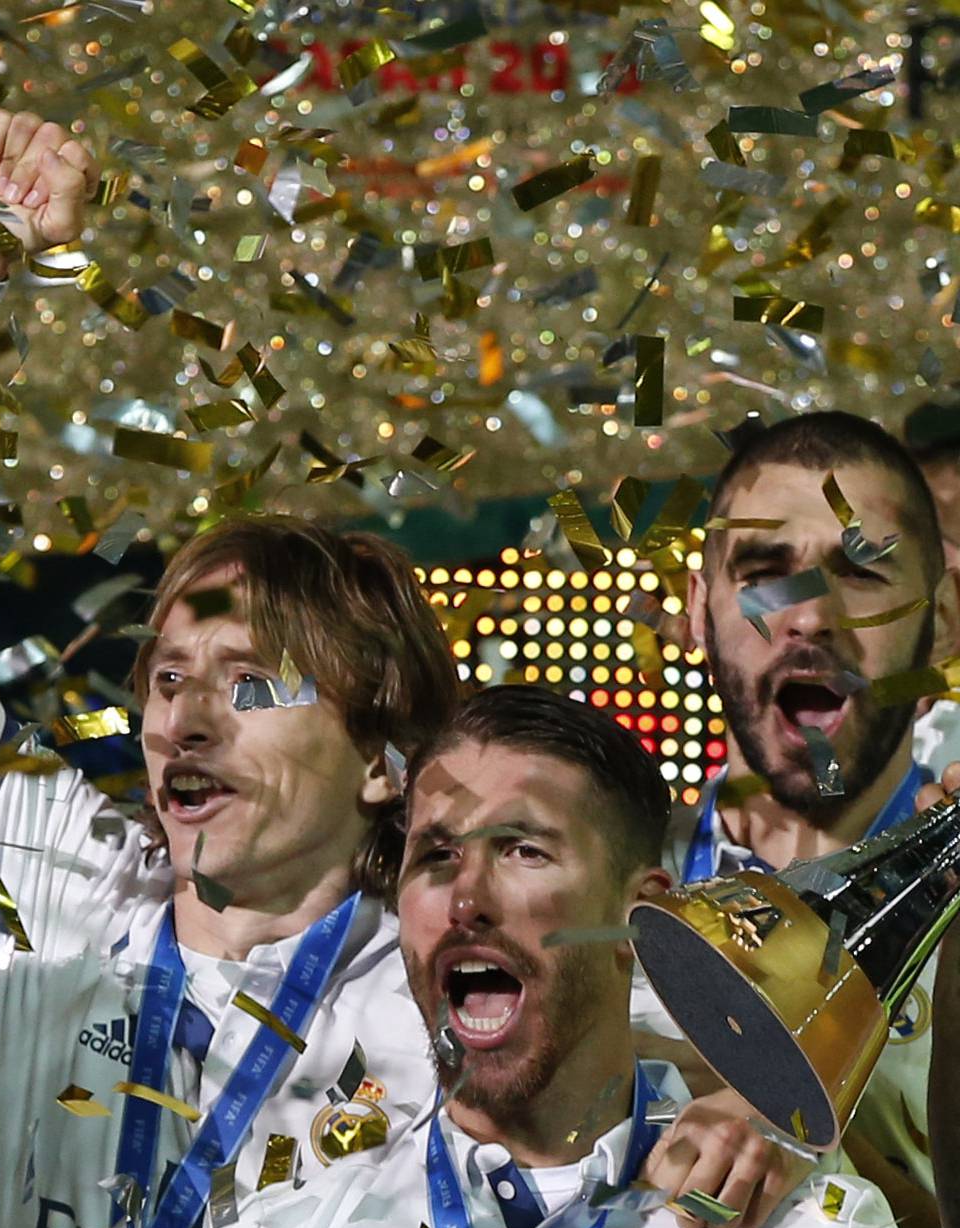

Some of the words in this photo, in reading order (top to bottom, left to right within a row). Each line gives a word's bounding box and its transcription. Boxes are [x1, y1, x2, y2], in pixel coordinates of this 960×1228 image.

[299, 953, 319, 986] FIFA
[79, 1029, 134, 1067] adida
[251, 1044, 274, 1079] FIFA
[224, 1093, 247, 1126] FIFA
